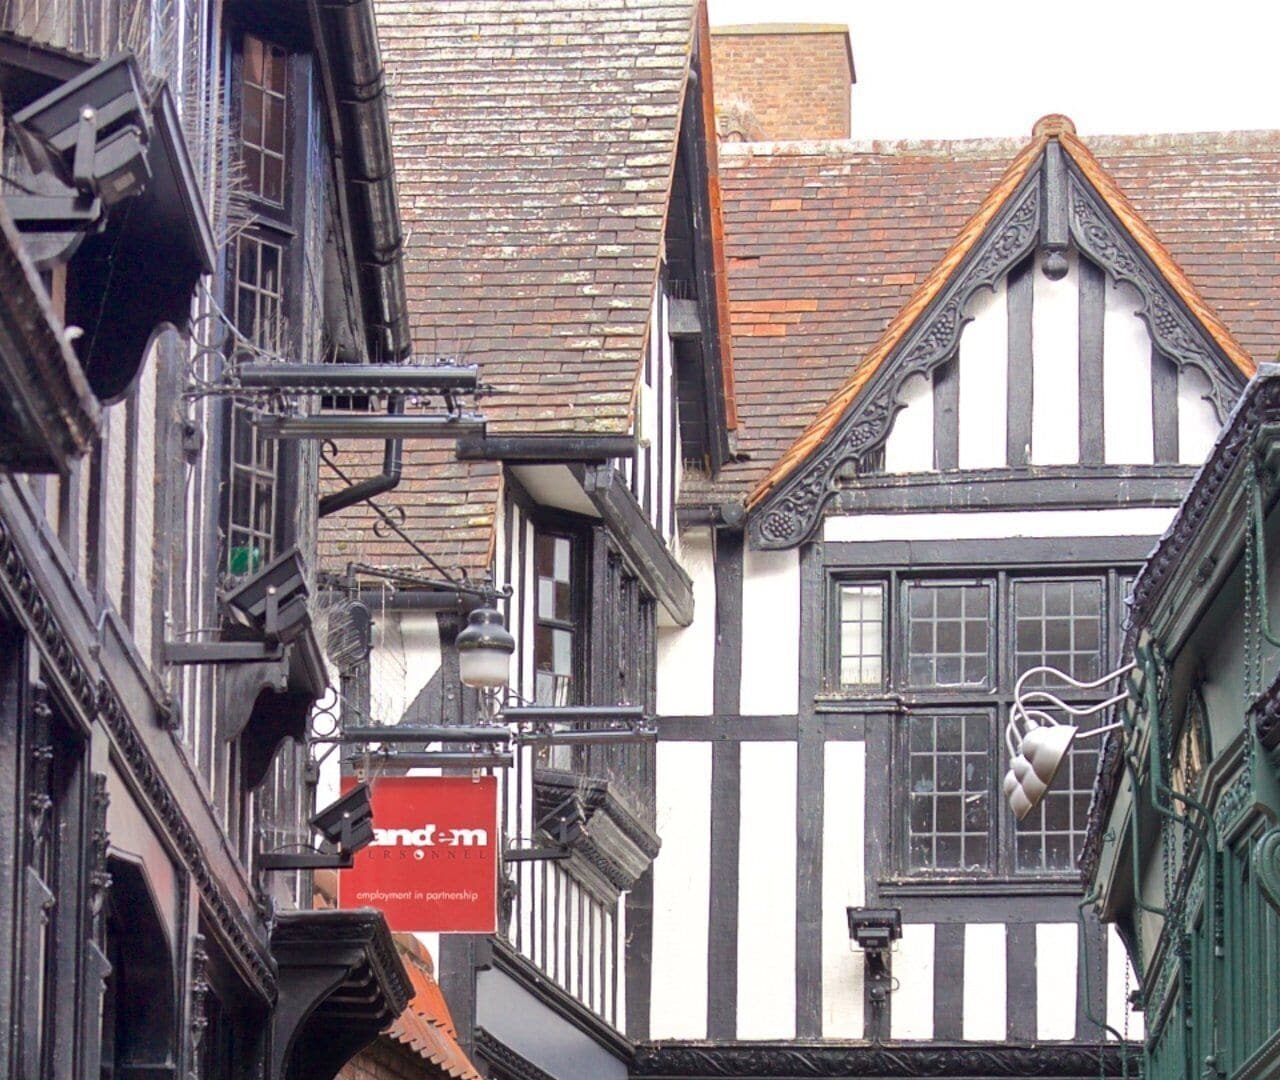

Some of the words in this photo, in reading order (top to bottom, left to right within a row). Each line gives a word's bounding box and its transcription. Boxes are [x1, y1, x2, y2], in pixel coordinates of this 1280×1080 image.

[369, 824, 488, 846] andem
[356, 889, 412, 901] employment
[414, 890, 424, 900] in
[426, 889, 479, 901] partnership
